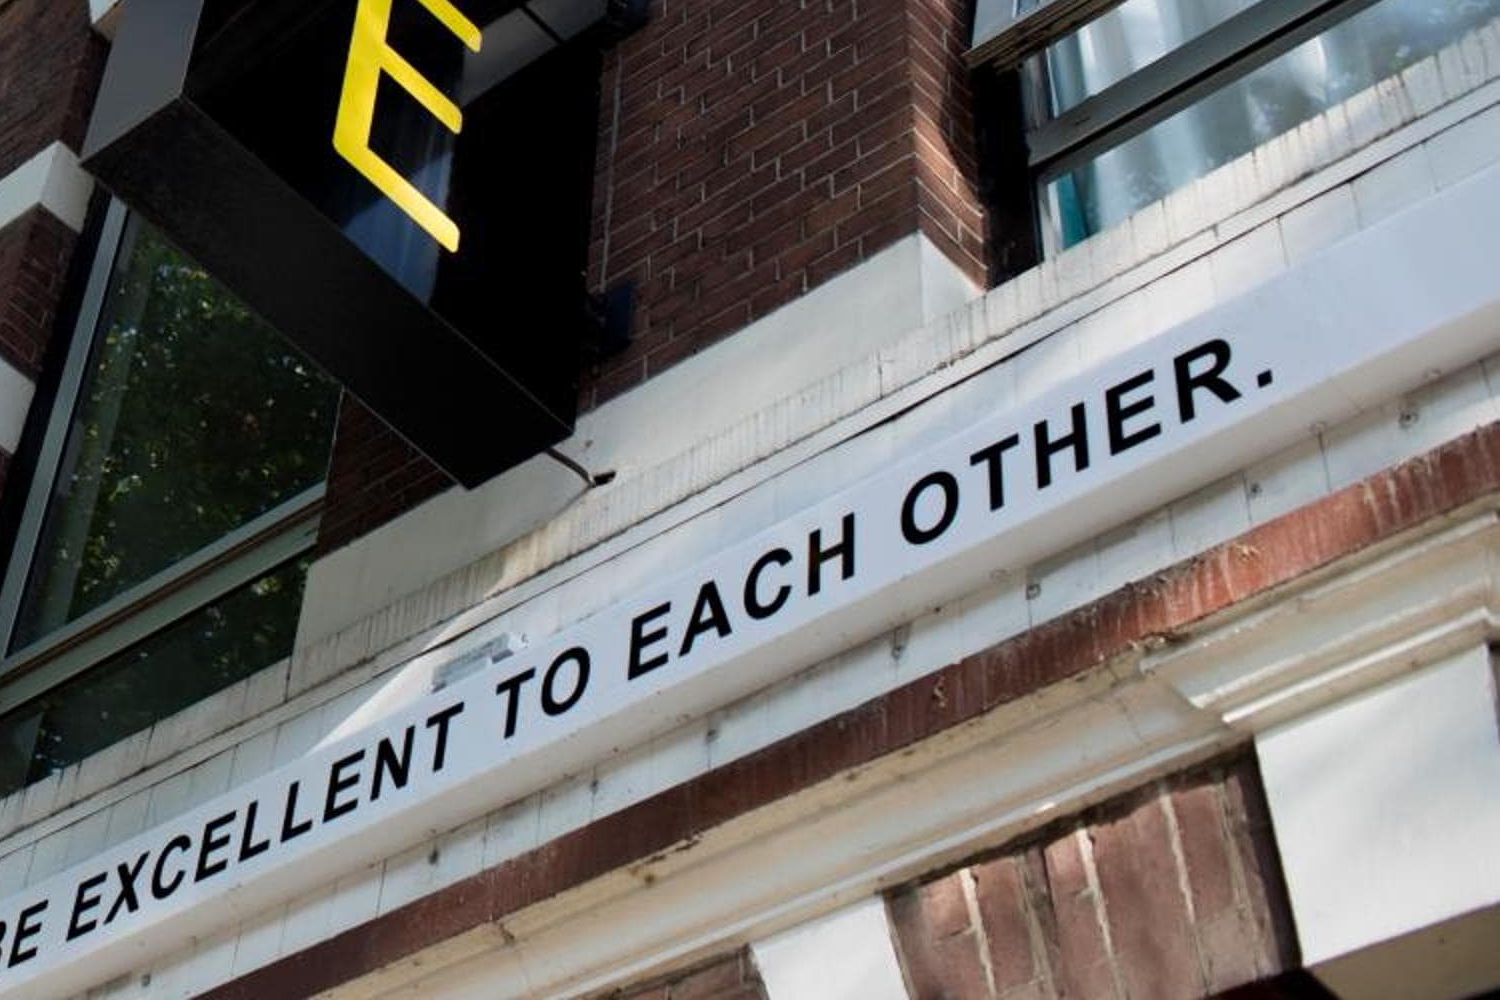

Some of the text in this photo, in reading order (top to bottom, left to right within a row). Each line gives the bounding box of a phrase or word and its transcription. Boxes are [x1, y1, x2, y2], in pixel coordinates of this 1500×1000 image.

[65, 702, 465, 942] EXCELLENT
[495, 646, 591, 739] TO
[626, 512, 856, 681] EACH
[900, 338, 1274, 546] OTHER.
